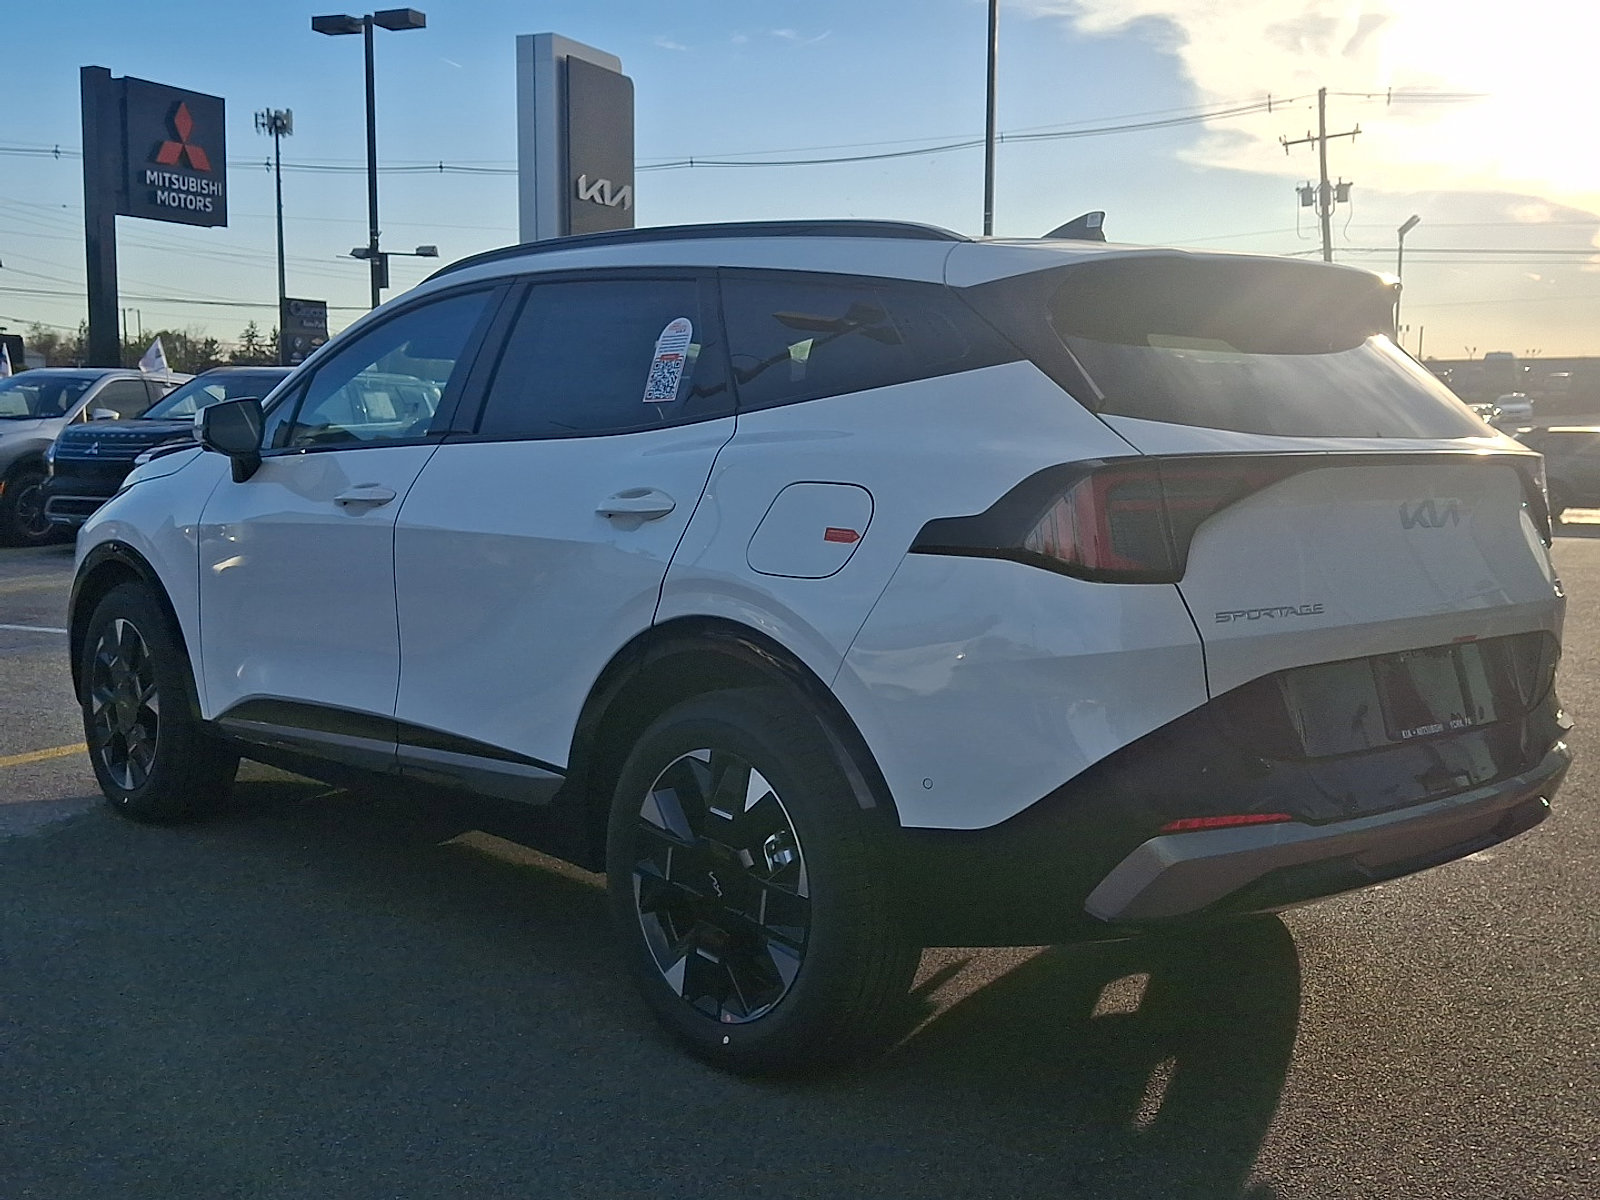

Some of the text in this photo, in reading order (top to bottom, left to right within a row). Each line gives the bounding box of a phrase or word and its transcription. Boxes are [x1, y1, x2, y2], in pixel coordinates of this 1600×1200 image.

[145, 169, 222, 197] MITSUBISHI
[578, 174, 632, 210] KIA
[156, 190, 214, 212] MOTORS
[1399, 499, 1460, 530] KIA
[1214, 603, 1325, 624] SPORTAGE
